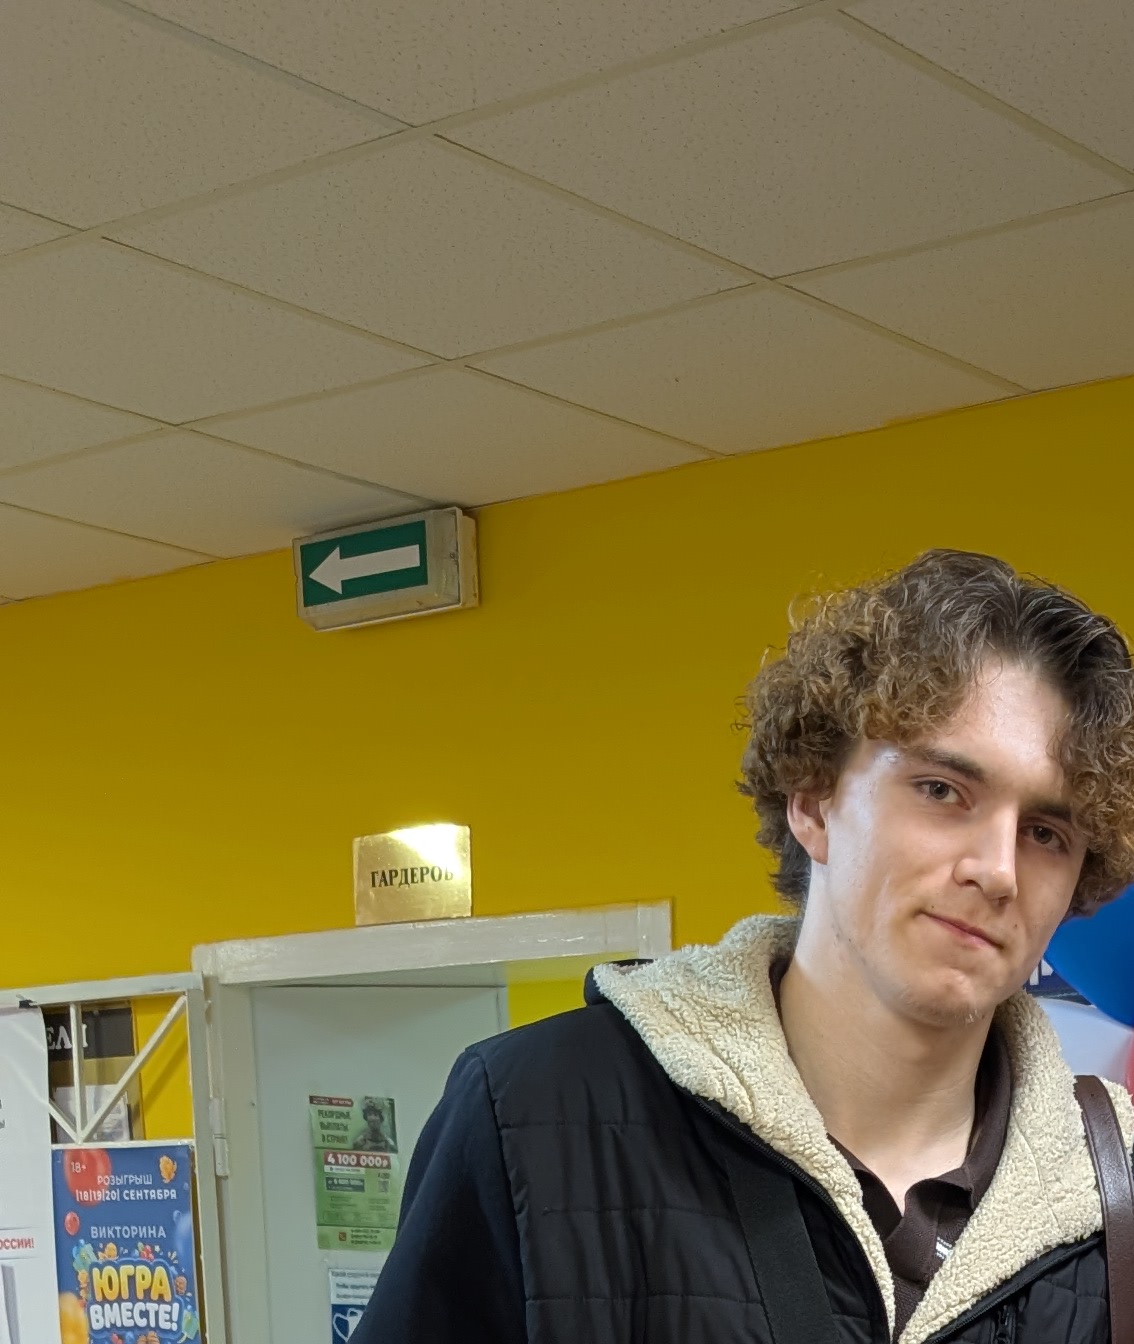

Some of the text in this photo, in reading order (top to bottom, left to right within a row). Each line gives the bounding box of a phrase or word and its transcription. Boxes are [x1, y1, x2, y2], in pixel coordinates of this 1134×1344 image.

[327, 1153, 336, 1164] 4
[337, 1154, 357, 1166] 100
[71, 1161, 87, 1173] 18+
[97, 1174, 153, 1186] РОЗЫГРЫШ
[123, 1189, 177, 1201] СЕНТЯБРЯ
[90, 1226, 167, 1239] ВИКТОРИНА
[92, 1265, 172, 1302] ЮГРА
[89, 1302, 180, 1332] ВМЕСТЕ!
